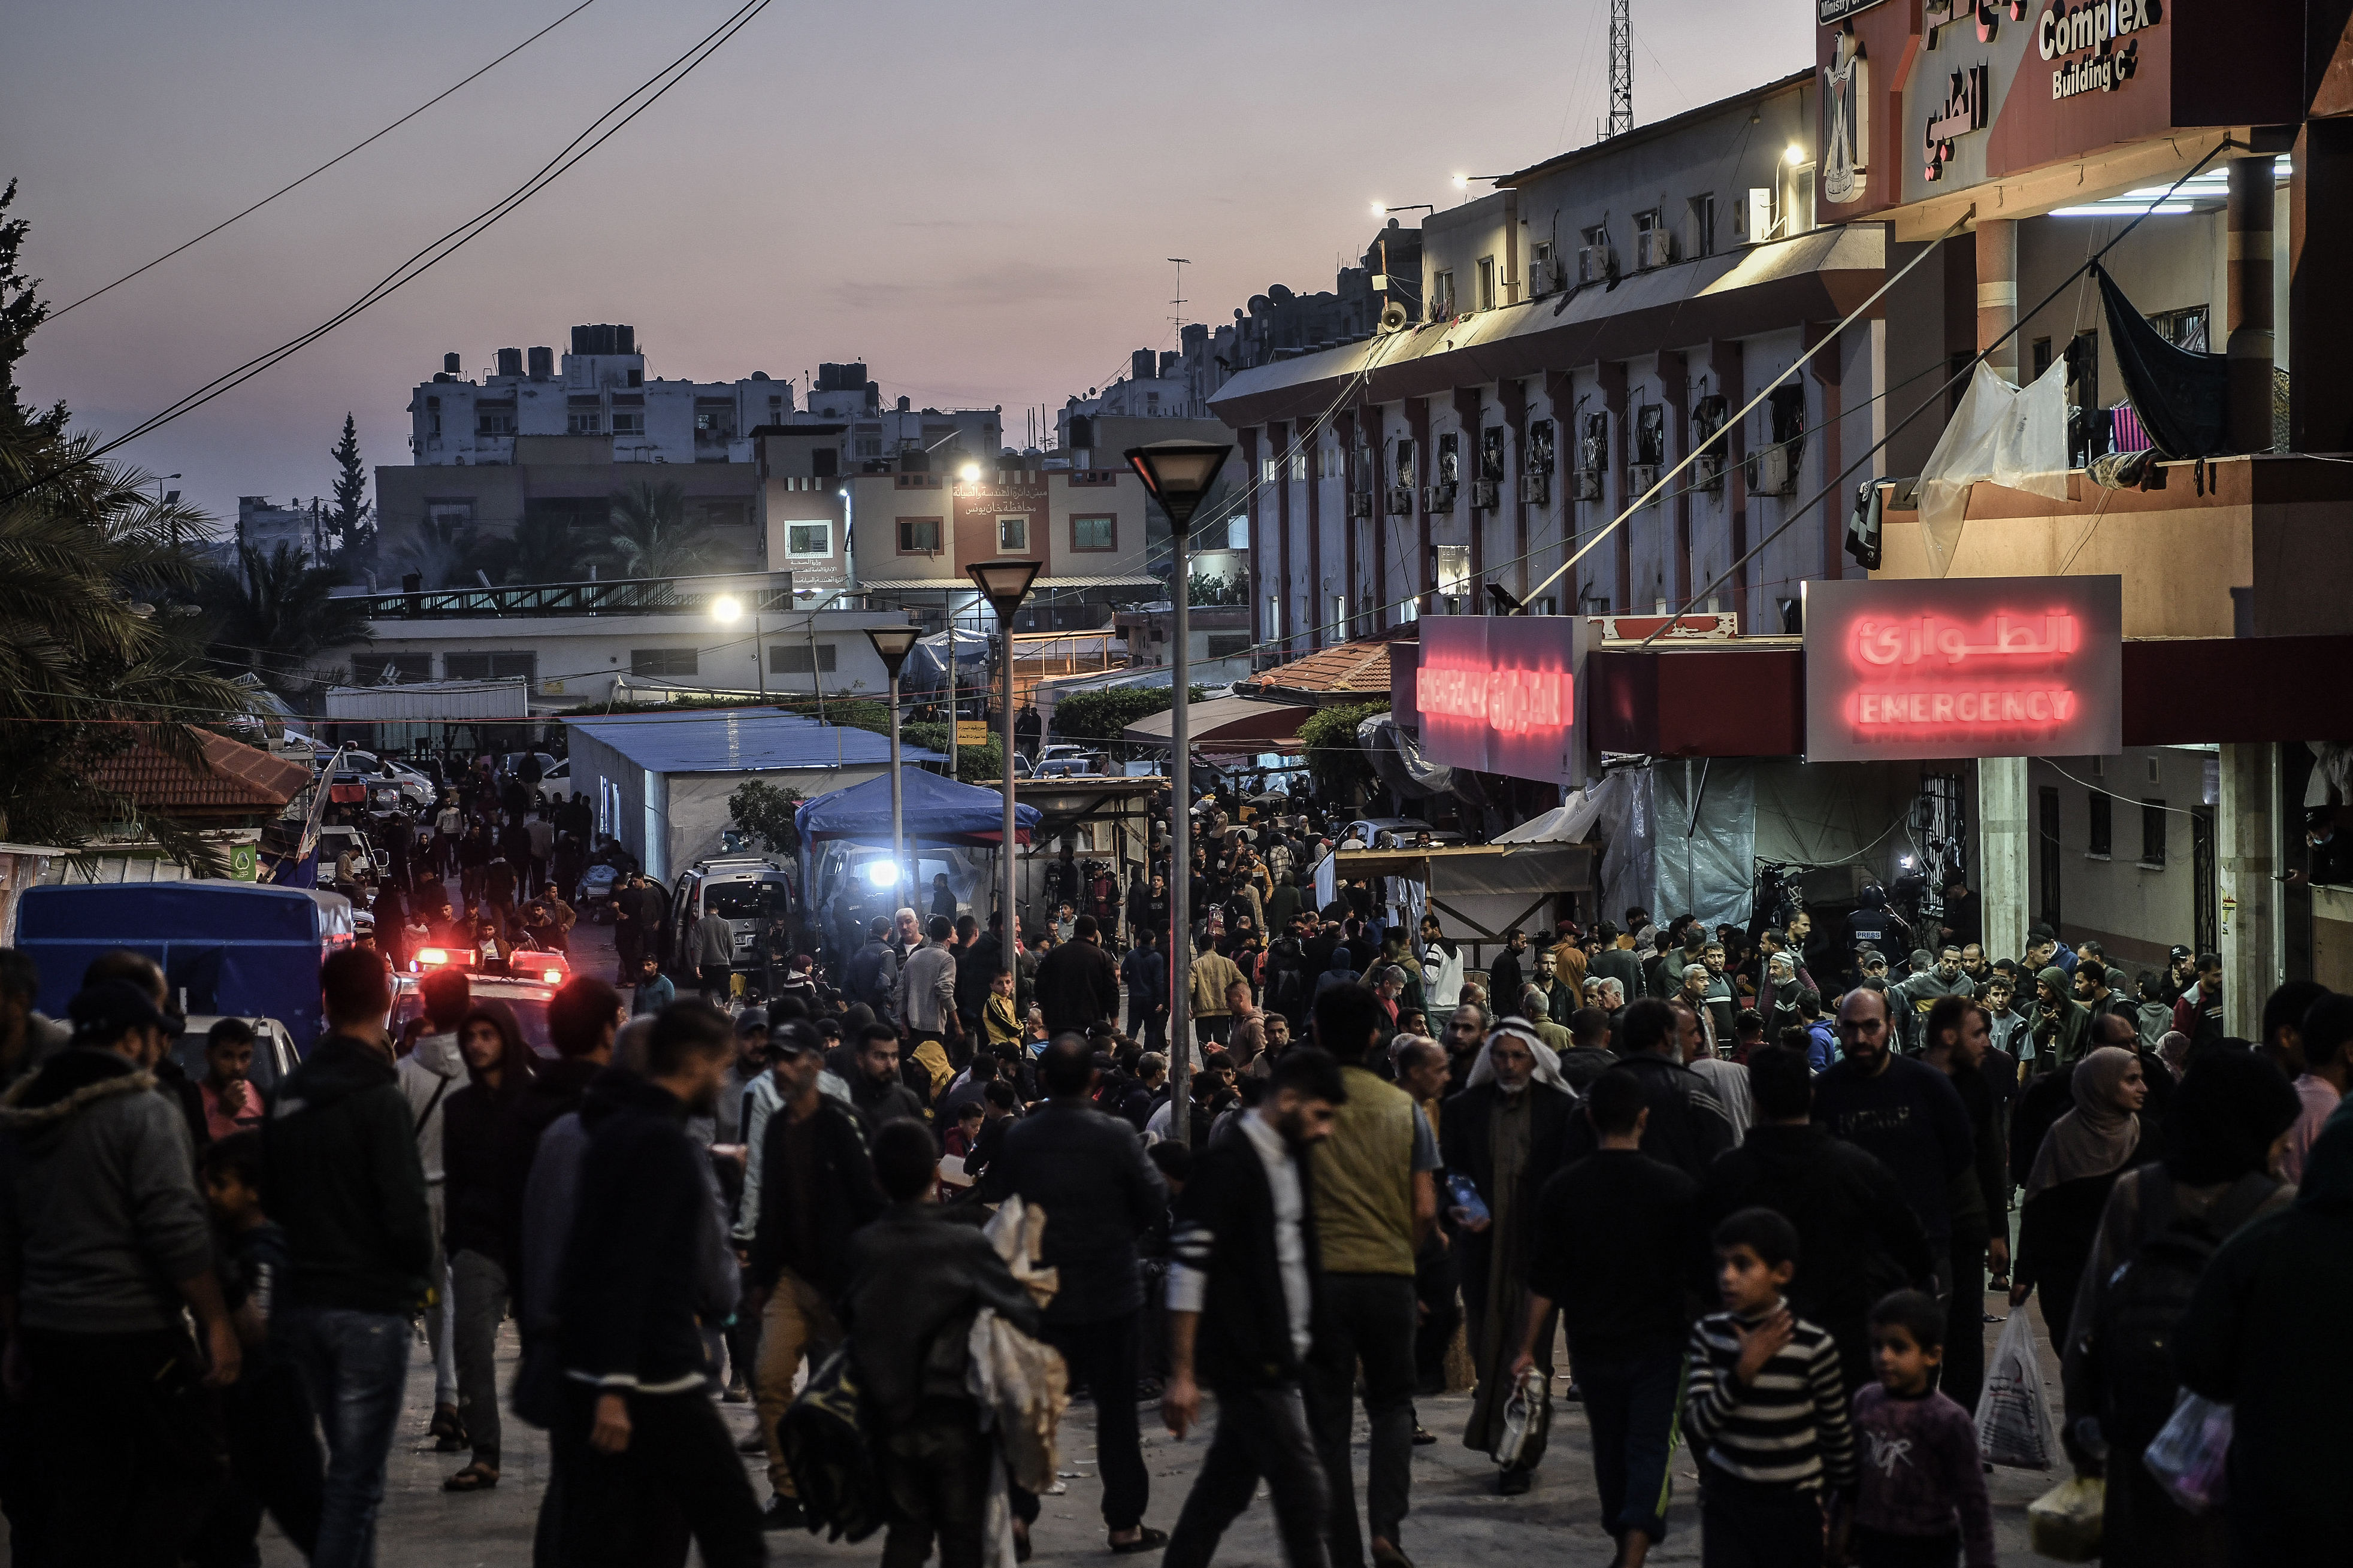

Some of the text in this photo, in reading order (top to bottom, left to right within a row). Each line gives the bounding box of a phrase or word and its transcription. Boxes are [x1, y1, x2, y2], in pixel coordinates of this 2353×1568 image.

[1821, 0, 1849, 17] Ministry
[2039, 0, 2149, 61] Complex
[2052, 50, 2125, 100] Building C
[1922, 65, 1983, 181] الطبي
[953, 485, 1048, 500] مبنى دائرة الهندسة والصيانة
[965, 501, 1036, 516] محافظة خان يونس
[1859, 616, 2073, 665] الطوارئ
[1859, 690, 2073, 724] EMERGENCY
